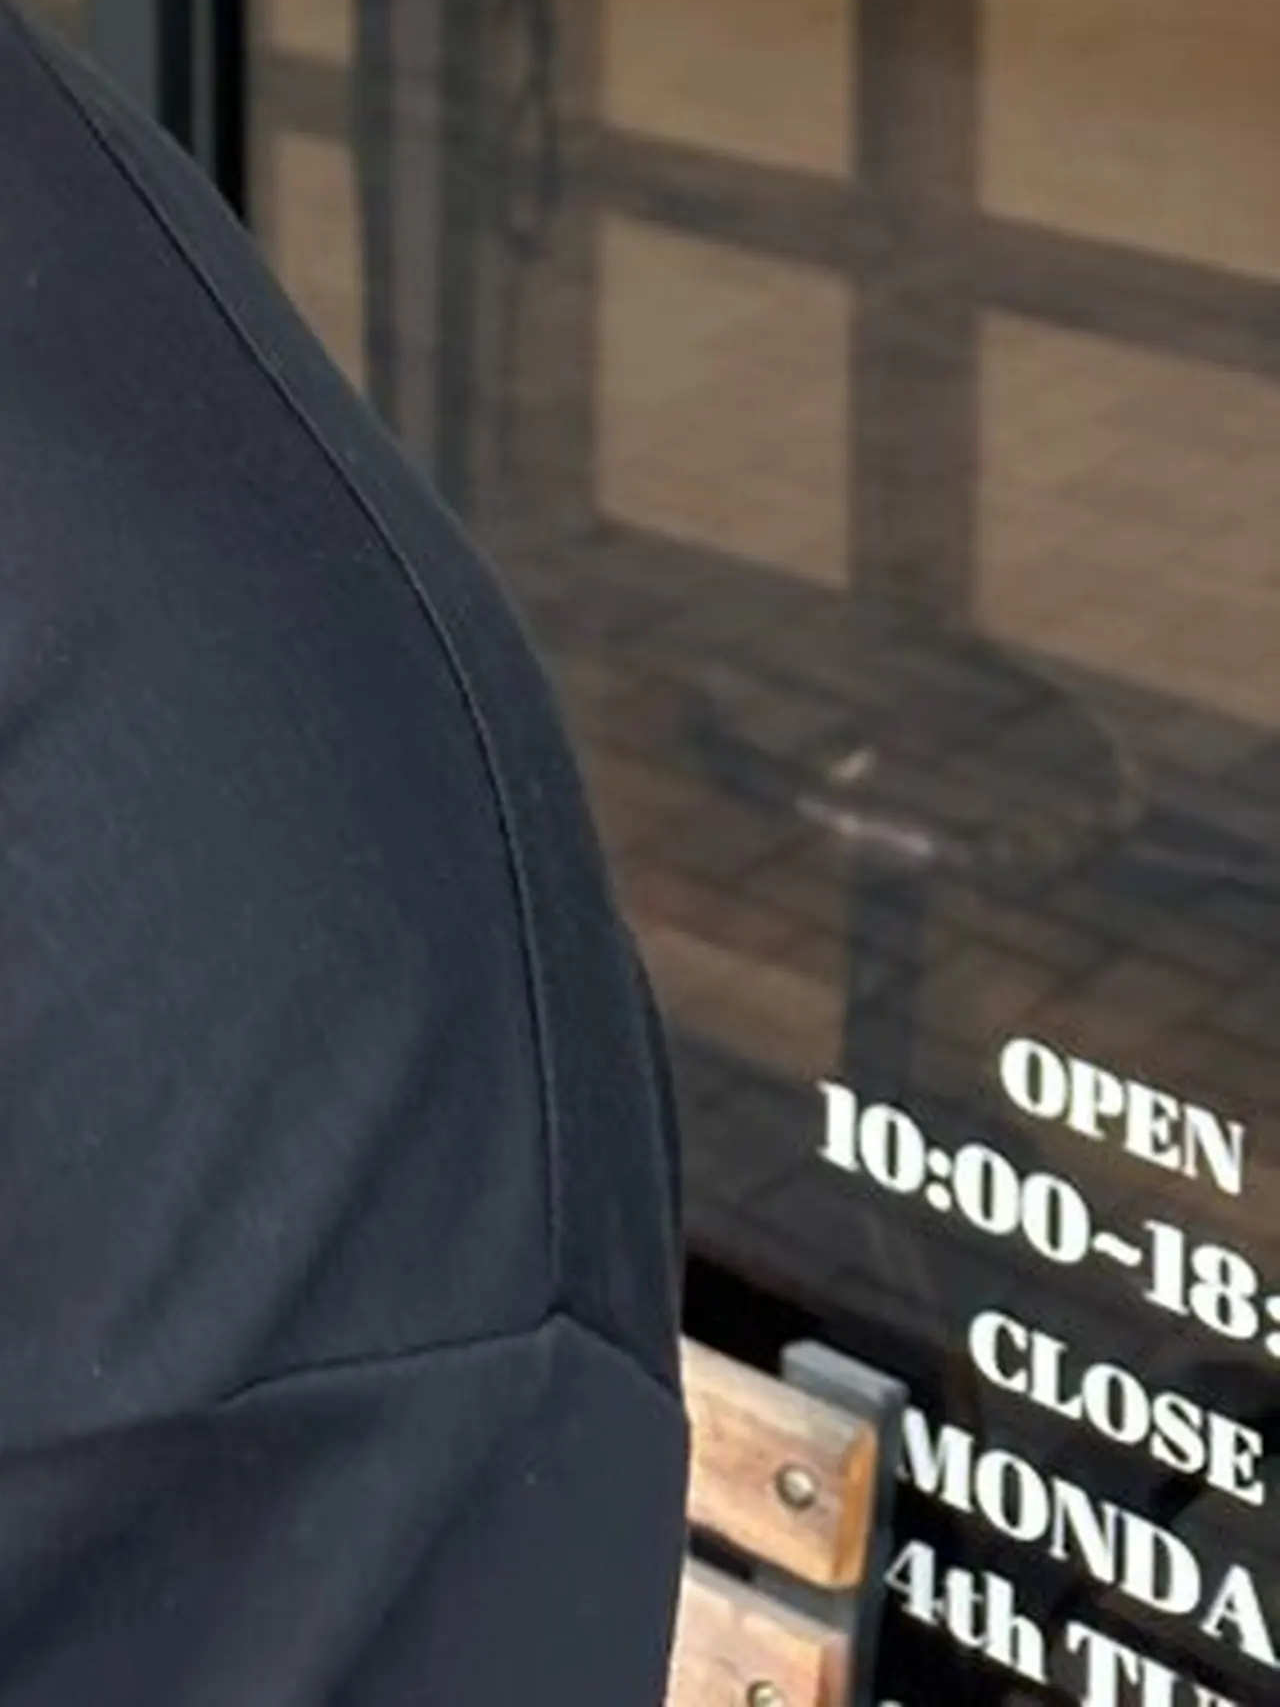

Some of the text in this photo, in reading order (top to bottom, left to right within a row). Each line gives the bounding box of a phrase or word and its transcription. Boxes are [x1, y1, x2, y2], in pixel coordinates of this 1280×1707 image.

[998, 1036, 1244, 1196] OPEN
[967, 1309, 1265, 1506] CLOSE
[883, 1539, 1046, 1684] 4th
[893, 1405, 1280, 1667] MONDA
